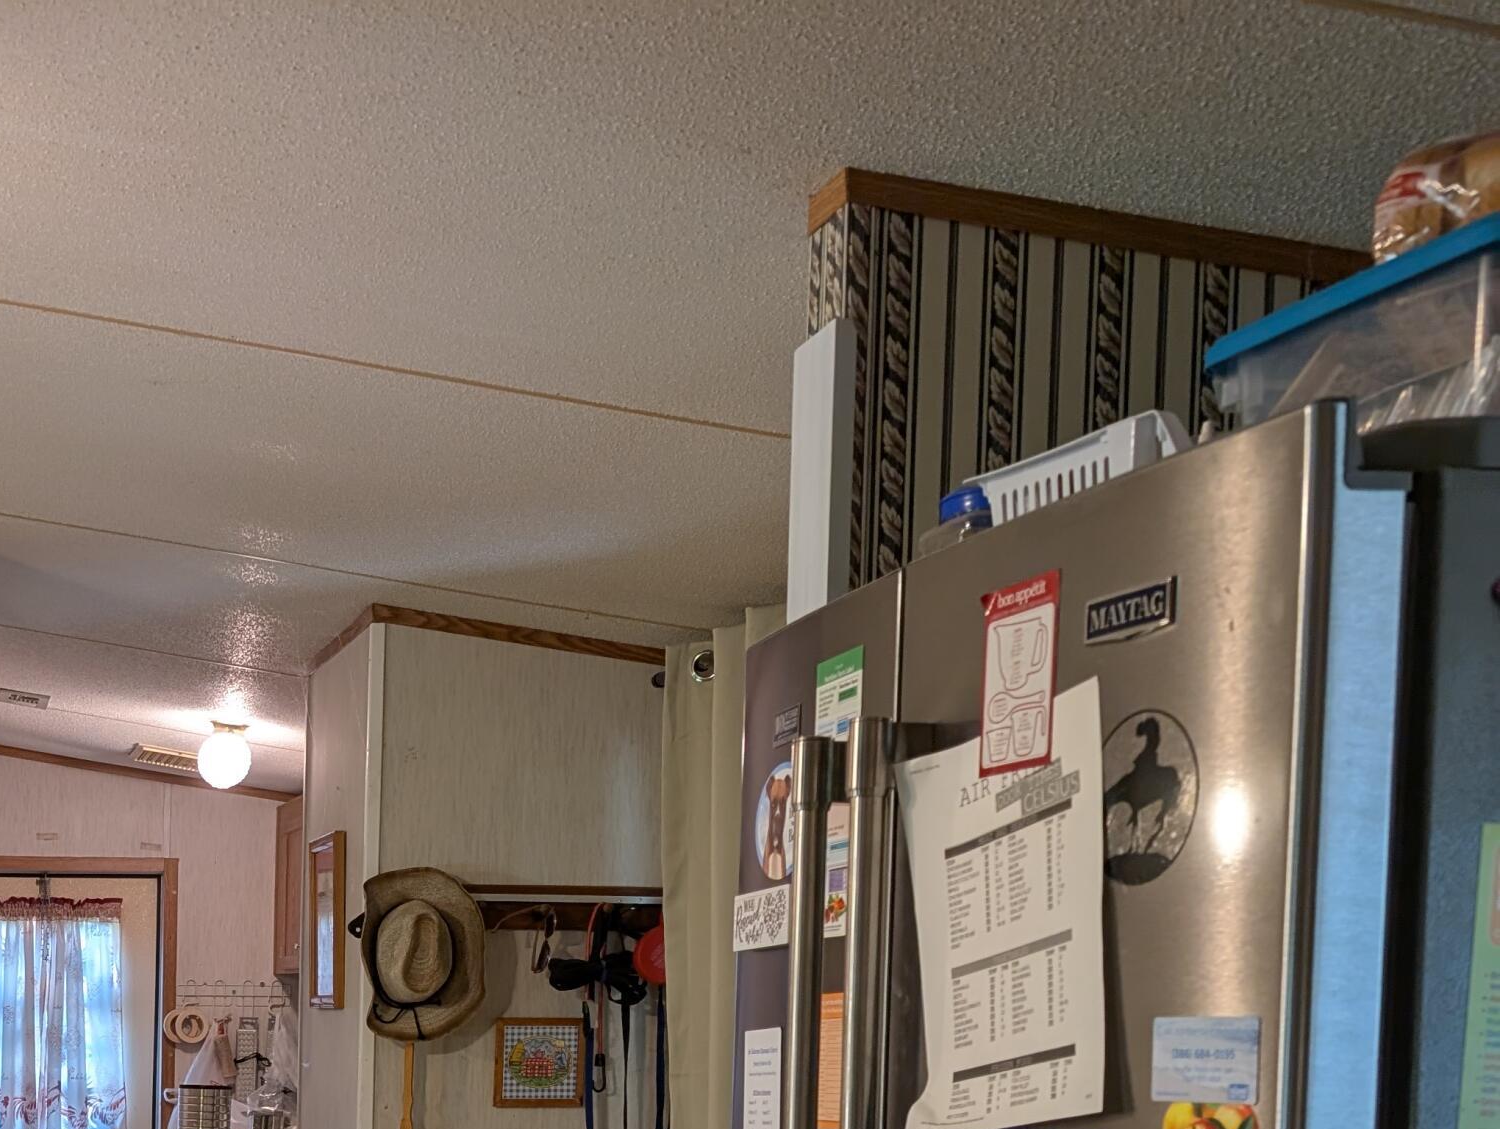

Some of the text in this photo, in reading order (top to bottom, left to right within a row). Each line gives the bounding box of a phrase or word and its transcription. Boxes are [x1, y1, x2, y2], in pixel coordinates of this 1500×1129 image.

[1088, 584, 1165, 635] MAYTAG
[959, 778, 991, 808] AIR
[1023, 773, 1079, 812] CELSIUS
